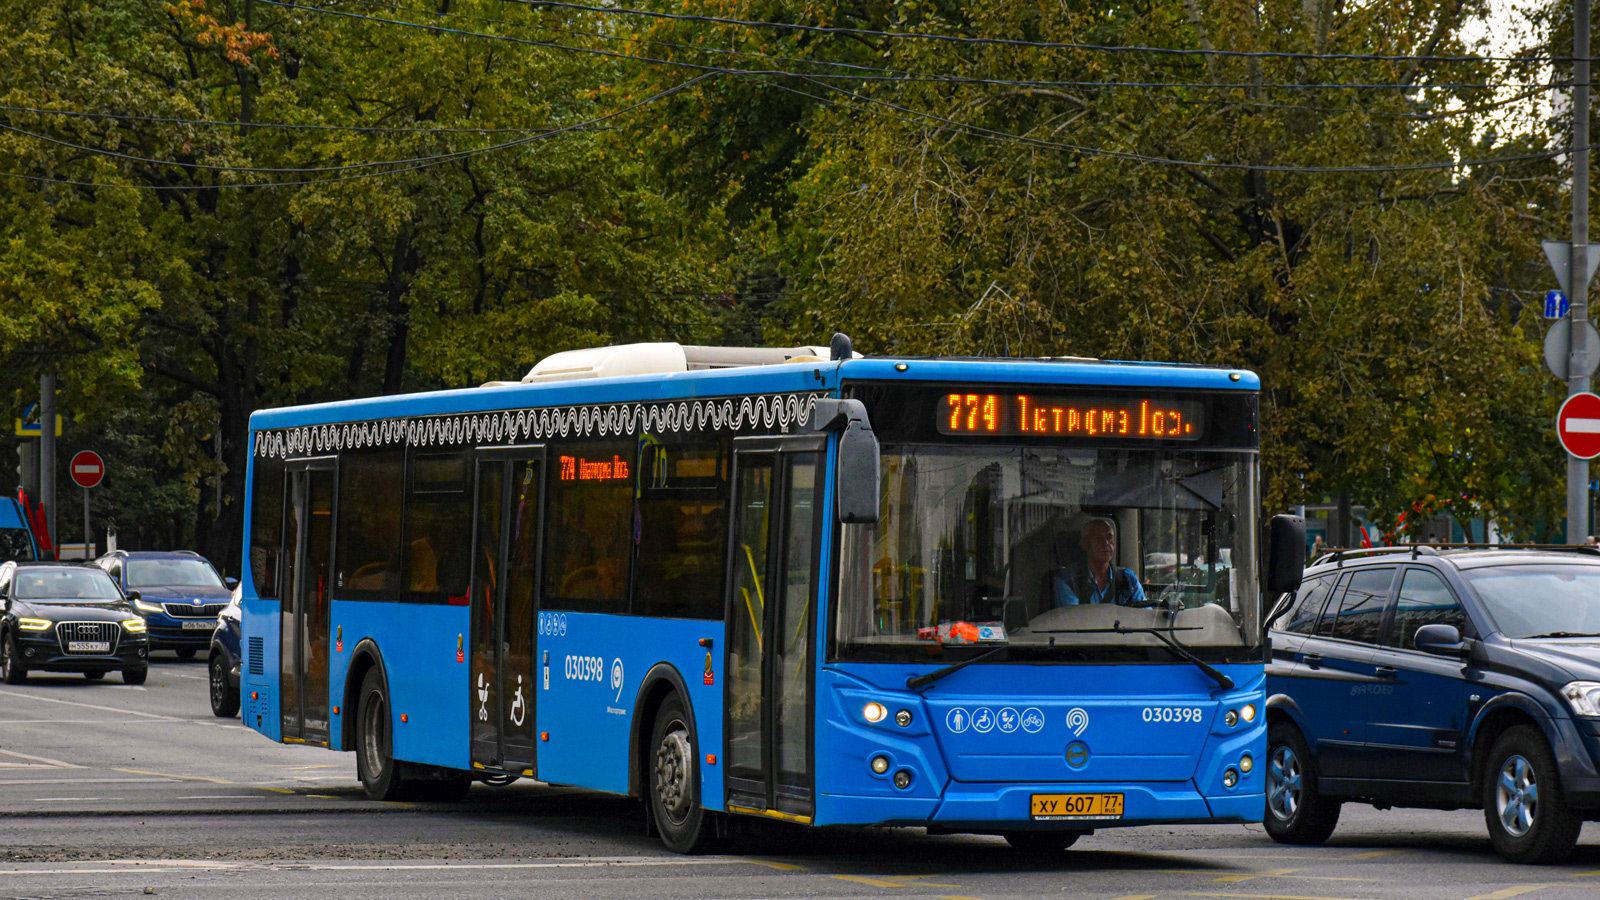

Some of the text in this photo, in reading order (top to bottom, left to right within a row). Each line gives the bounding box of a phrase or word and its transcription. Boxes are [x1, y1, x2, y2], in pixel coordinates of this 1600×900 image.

[949, 393, 996, 430] 774
[565, 654, 603, 682] 030398
[1142, 707, 1202, 722] 030398
[1065, 797, 1094, 813] 607
[1103, 796, 1118, 808] 77
